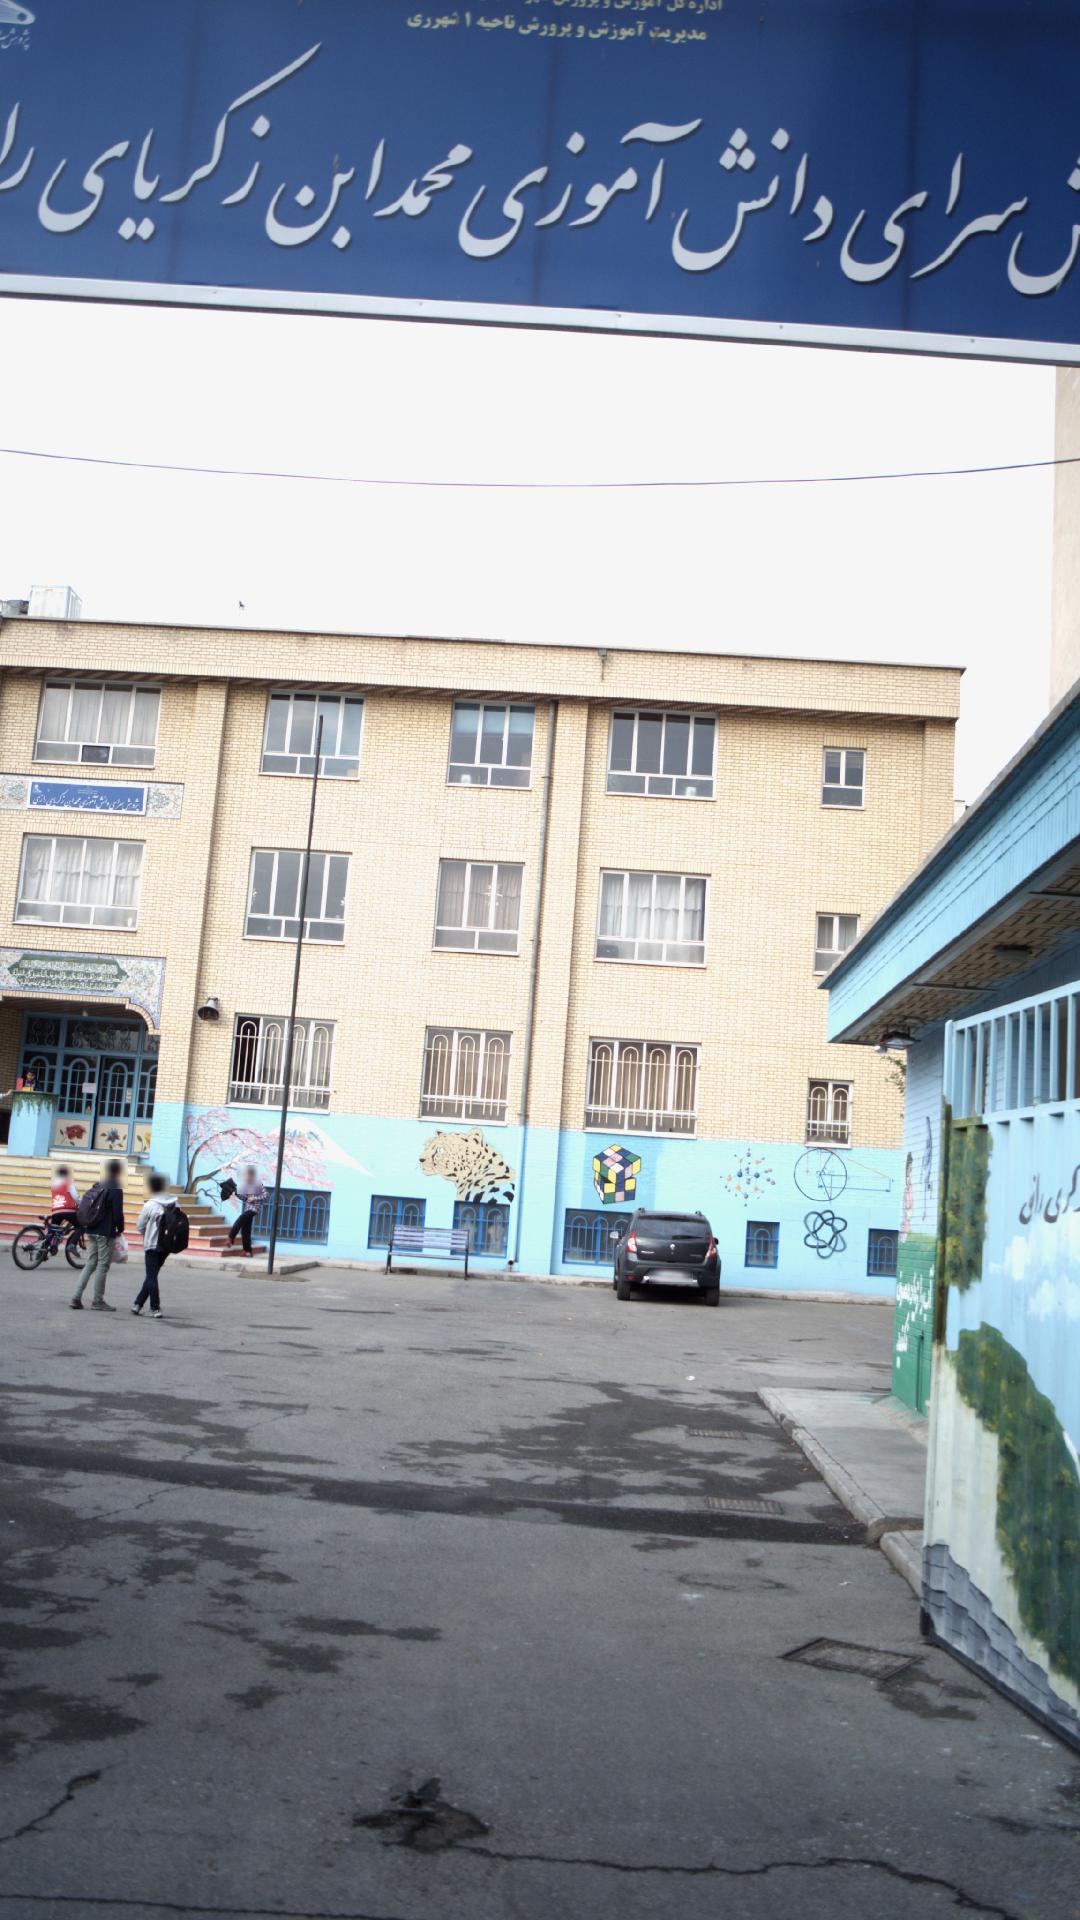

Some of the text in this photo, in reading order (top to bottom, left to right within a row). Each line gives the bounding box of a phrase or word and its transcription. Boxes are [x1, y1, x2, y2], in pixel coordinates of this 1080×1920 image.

[476, 14, 515, 30] ناحیه
[518, 17, 573, 37] پرورش
[576, 25, 585, 37] و
[588, 20, 648, 40] آموزش
[649, 27, 707, 43] مدیریت
[38, 42, 322, 240] زکریای
[265, 138, 386, 249] ابن
[373, 144, 473, 217] محمد
[457, 118, 702, 258] آموزی
[672, 128, 834, 271] دانش
[840, 152, 1028, 282] سرای
